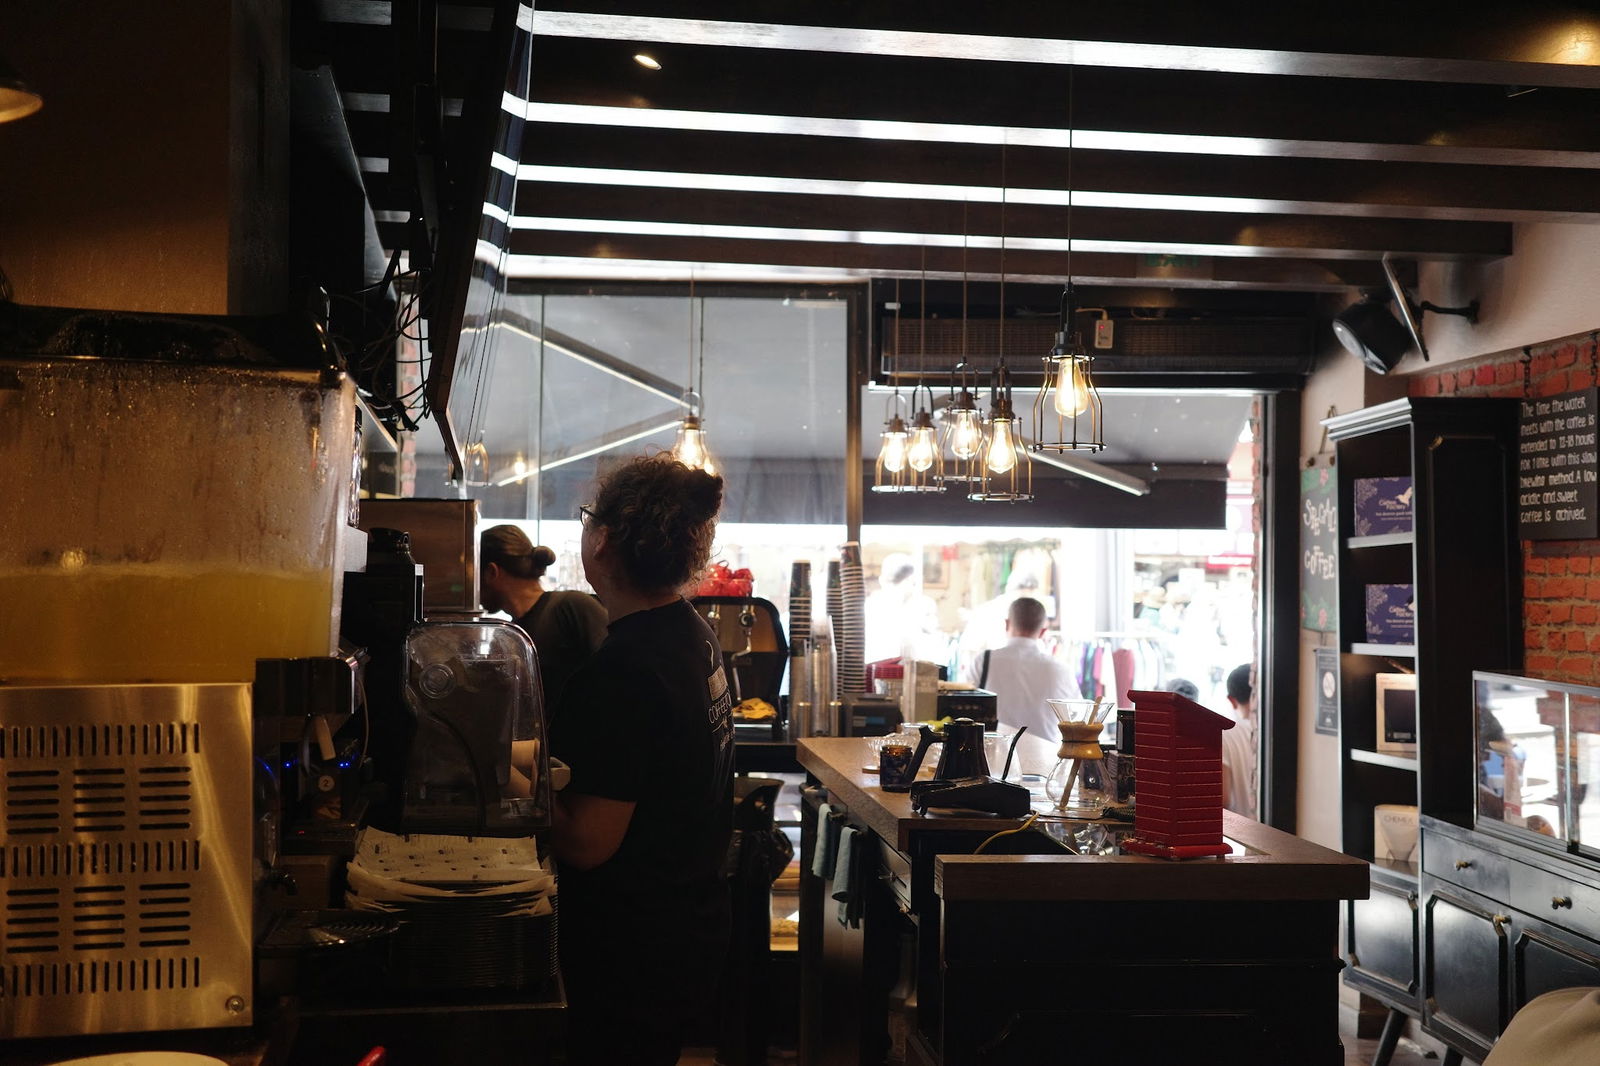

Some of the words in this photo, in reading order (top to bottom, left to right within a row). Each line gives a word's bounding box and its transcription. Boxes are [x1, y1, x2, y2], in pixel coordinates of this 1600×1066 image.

[1566, 416, 1587, 429] coffee
[1588, 414, 1595, 426] is
[1576, 470, 1582, 483] A
[1584, 469, 1597, 482] low
[1556, 489, 1578, 503] sweet
[1520, 510, 1543, 523] coffee
[1545, 508, 1551, 522] is
[1304, 545, 1336, 580] COFFEE
[323, 779, 329, 787] 2
